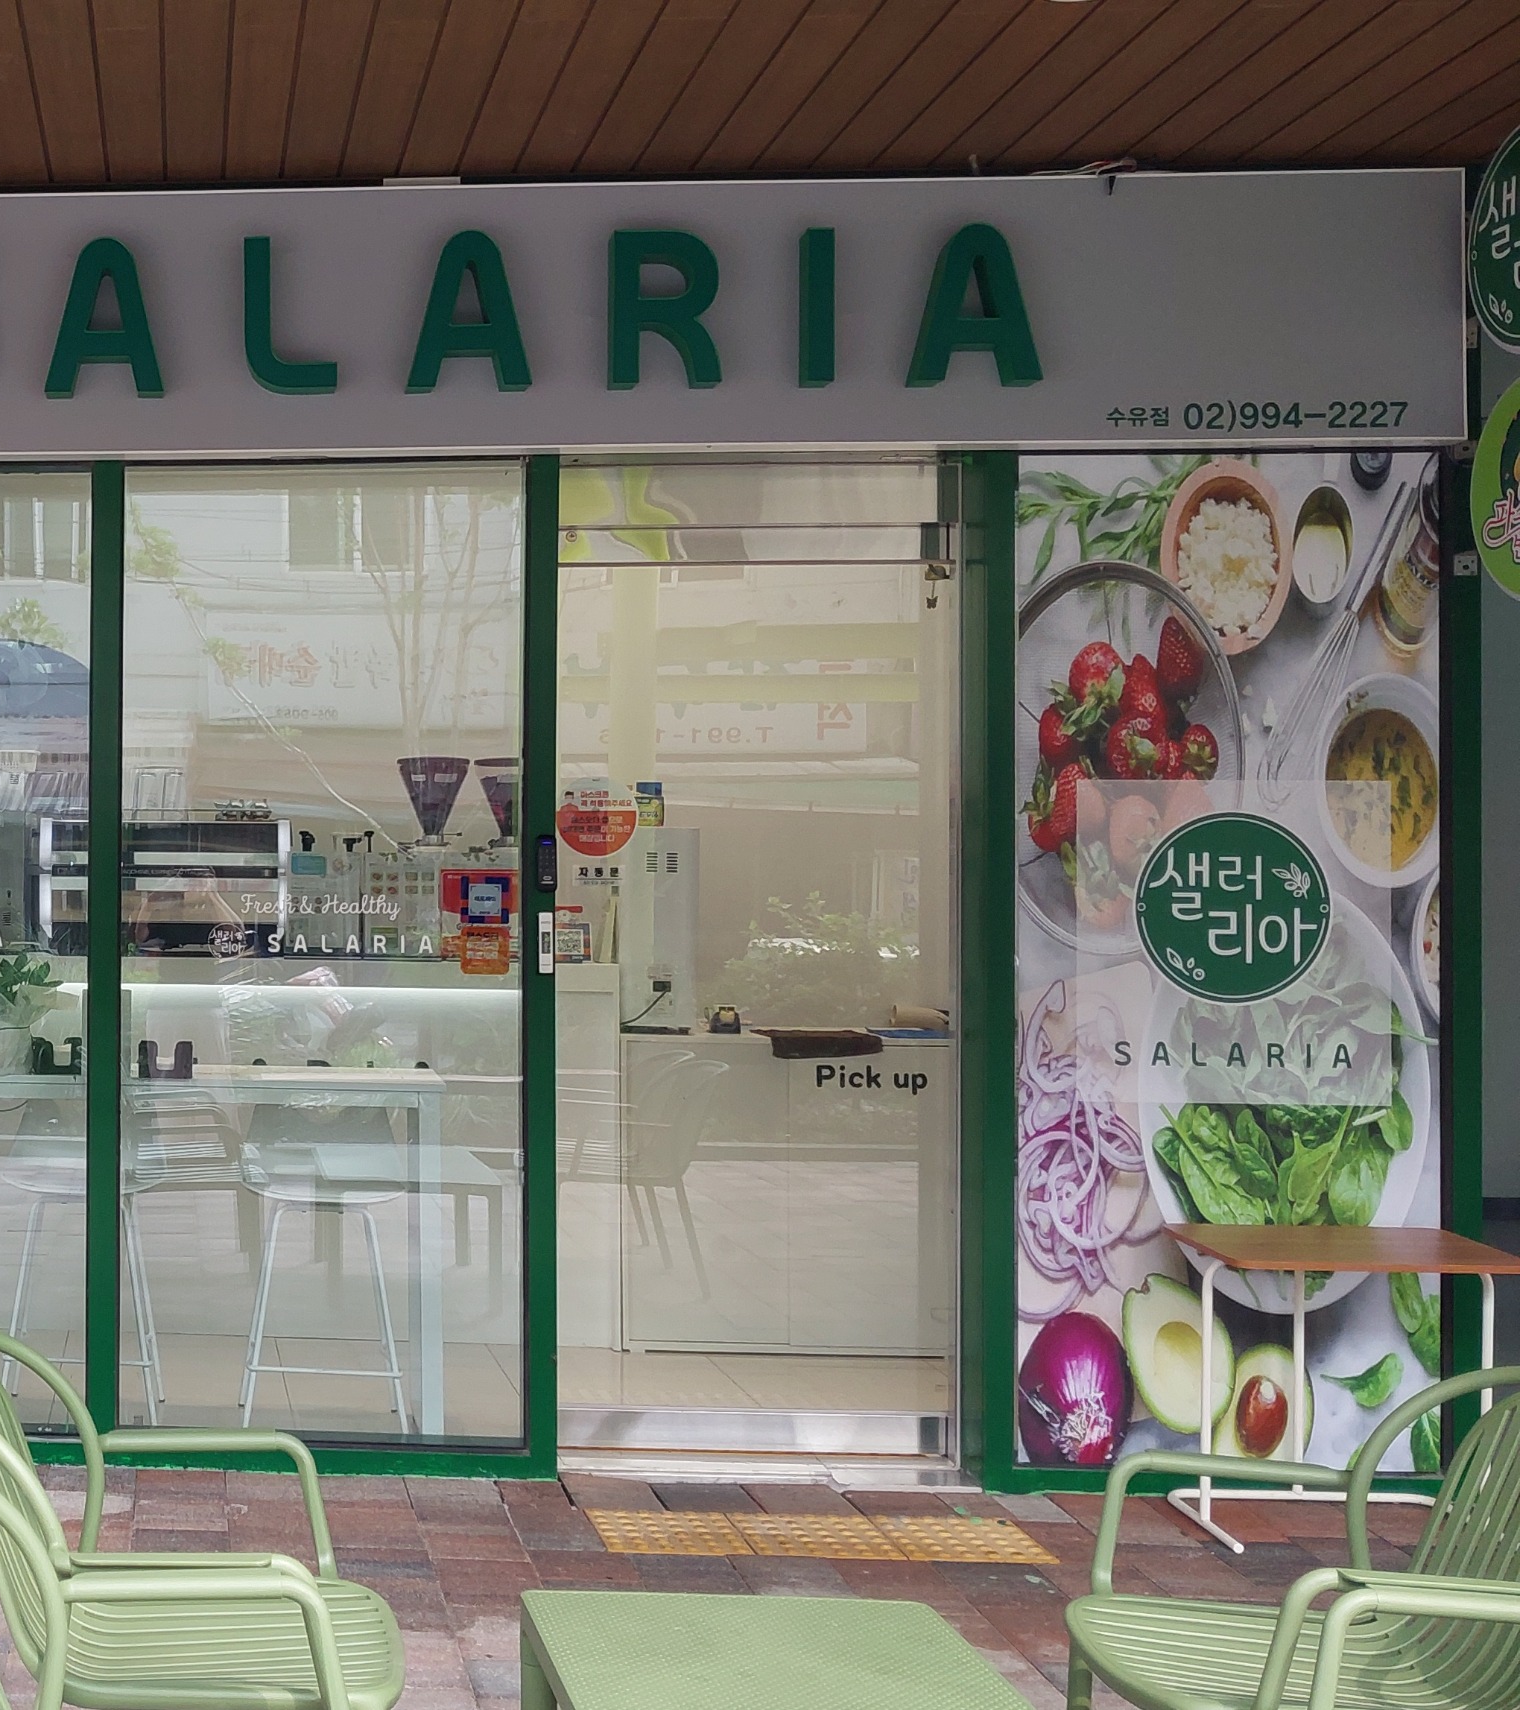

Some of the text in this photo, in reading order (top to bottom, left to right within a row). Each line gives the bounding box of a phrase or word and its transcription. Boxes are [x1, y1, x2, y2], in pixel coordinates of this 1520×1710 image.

[1106, 400, 1408, 432] 수유점 02)994-2227
[1149, 847, 1263, 921] 샐러
[240, 893, 401, 920] Fresh & Healthy
[267, 932, 433, 954] SALARIA
[1208, 904, 1318, 967] 리아
[1114, 1041, 1352, 1069] SALARIA
[816, 1064, 928, 1096] Pick up
